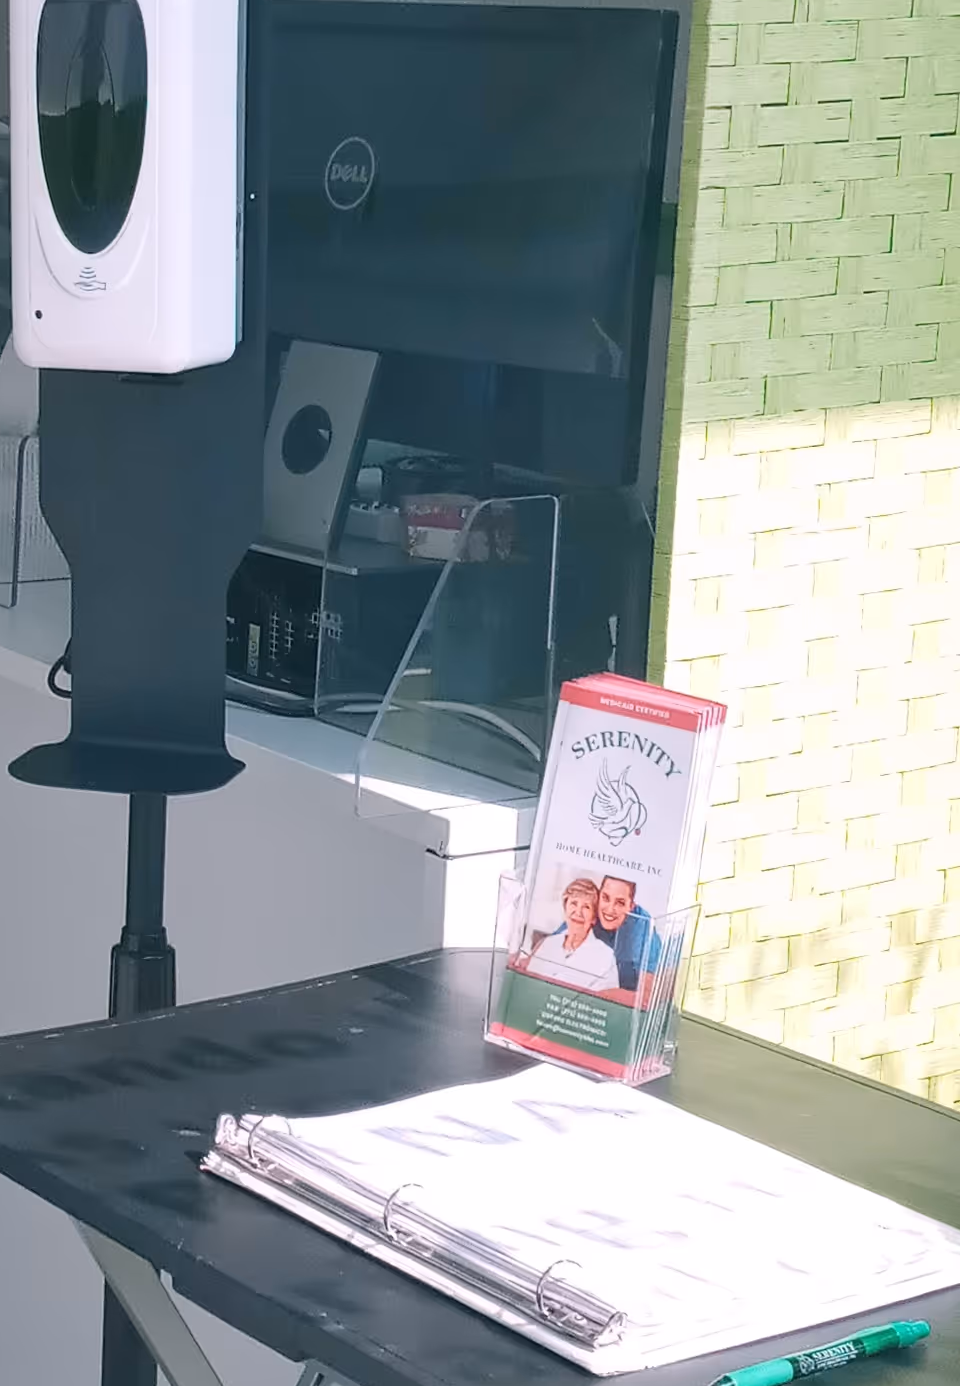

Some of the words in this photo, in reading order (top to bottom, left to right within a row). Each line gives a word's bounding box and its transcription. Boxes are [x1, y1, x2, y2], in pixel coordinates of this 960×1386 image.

[330, 163, 367, 183] DELL
[571, 730, 682, 780] SERENITY
[555, 841, 582, 856] HOME
